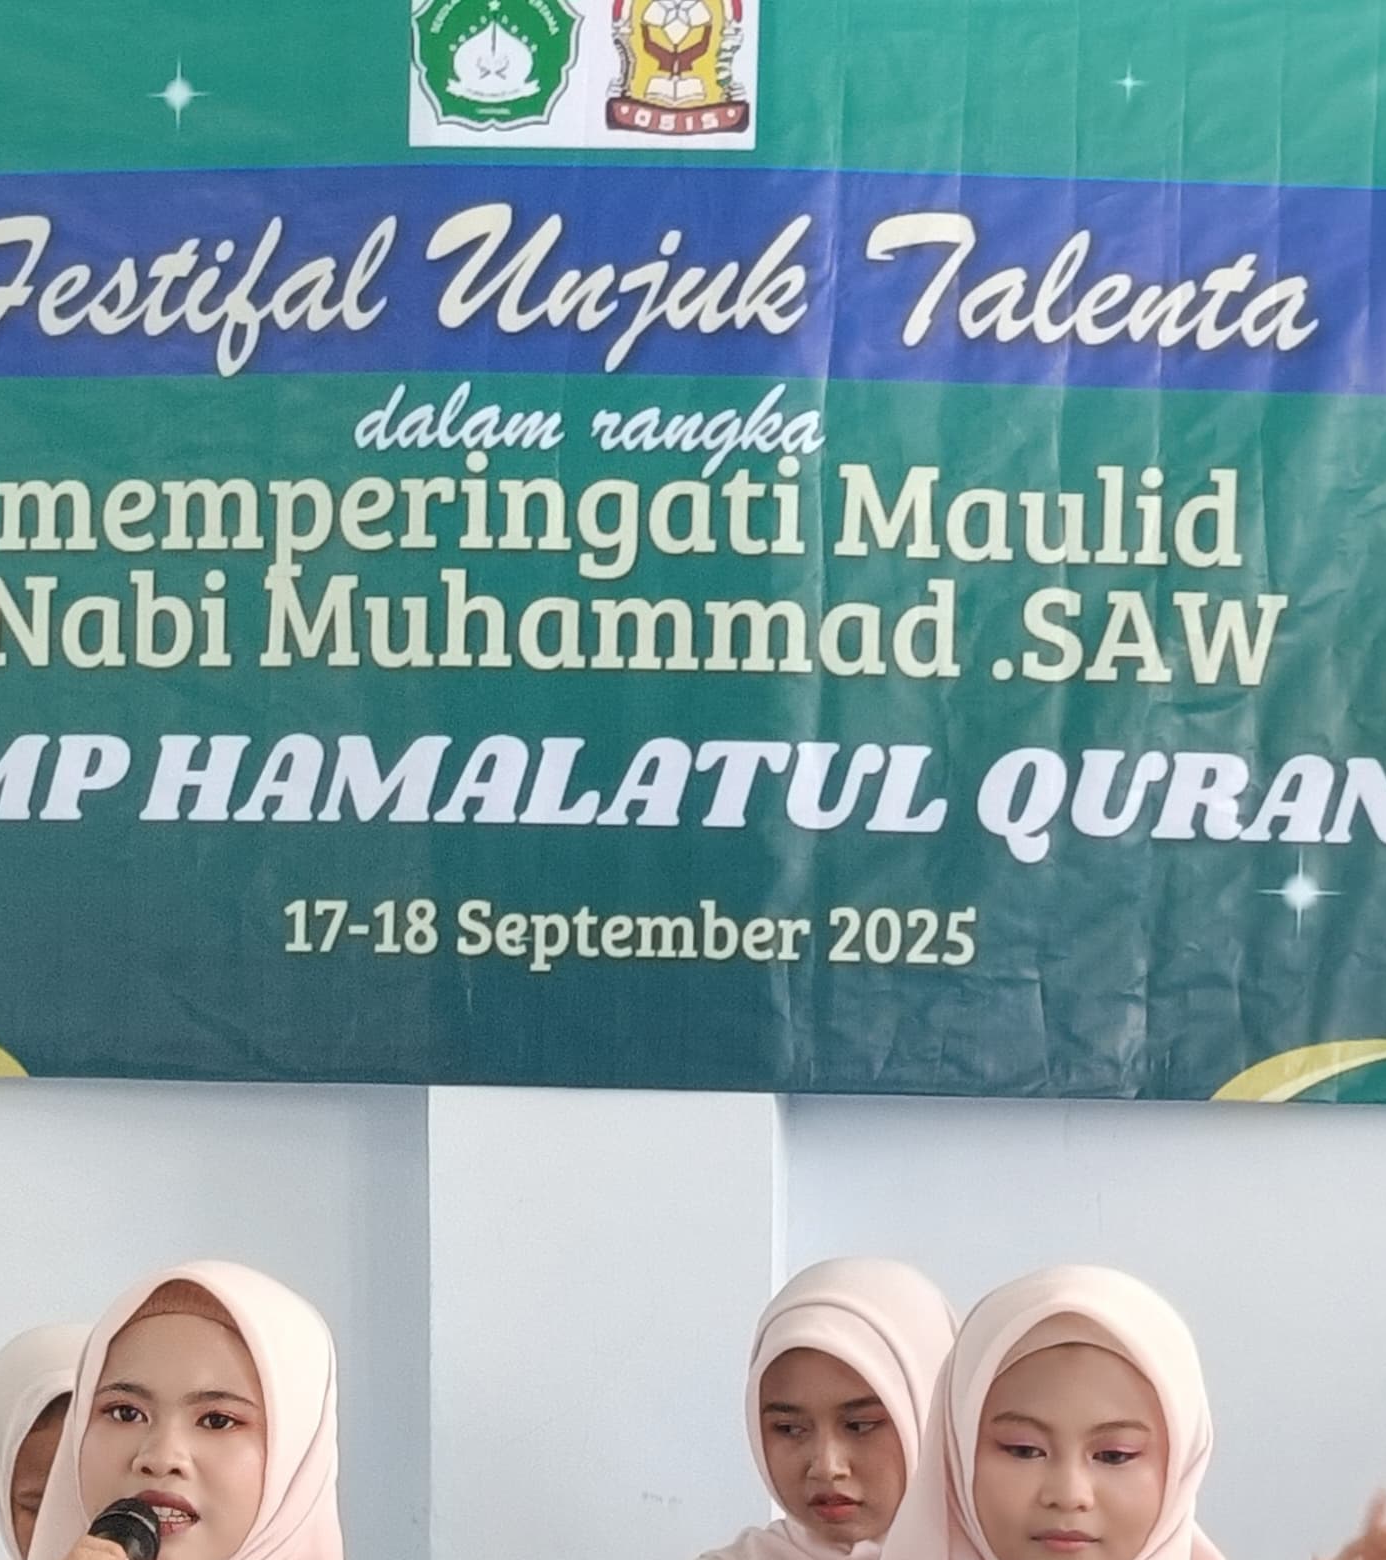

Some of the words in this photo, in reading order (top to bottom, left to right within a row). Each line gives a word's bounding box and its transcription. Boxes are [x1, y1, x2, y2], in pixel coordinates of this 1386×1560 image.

[634, 108, 719, 131] OSIS
[425, 203, 813, 373] Unjuk
[865, 211, 1319, 351] Talenta
[354, 380, 565, 450] dalam
[591, 383, 826, 479] rangka
[833, 463, 1242, 568] Maulid
[259, 568, 961, 679] Muhammad
[991, 586, 1289, 686] .SAW
[138, 732, 948, 834] HAMALATUL
[283, 899, 439, 955] 17-18
[455, 899, 812, 972] September
[827, 906, 978, 966] 2025
